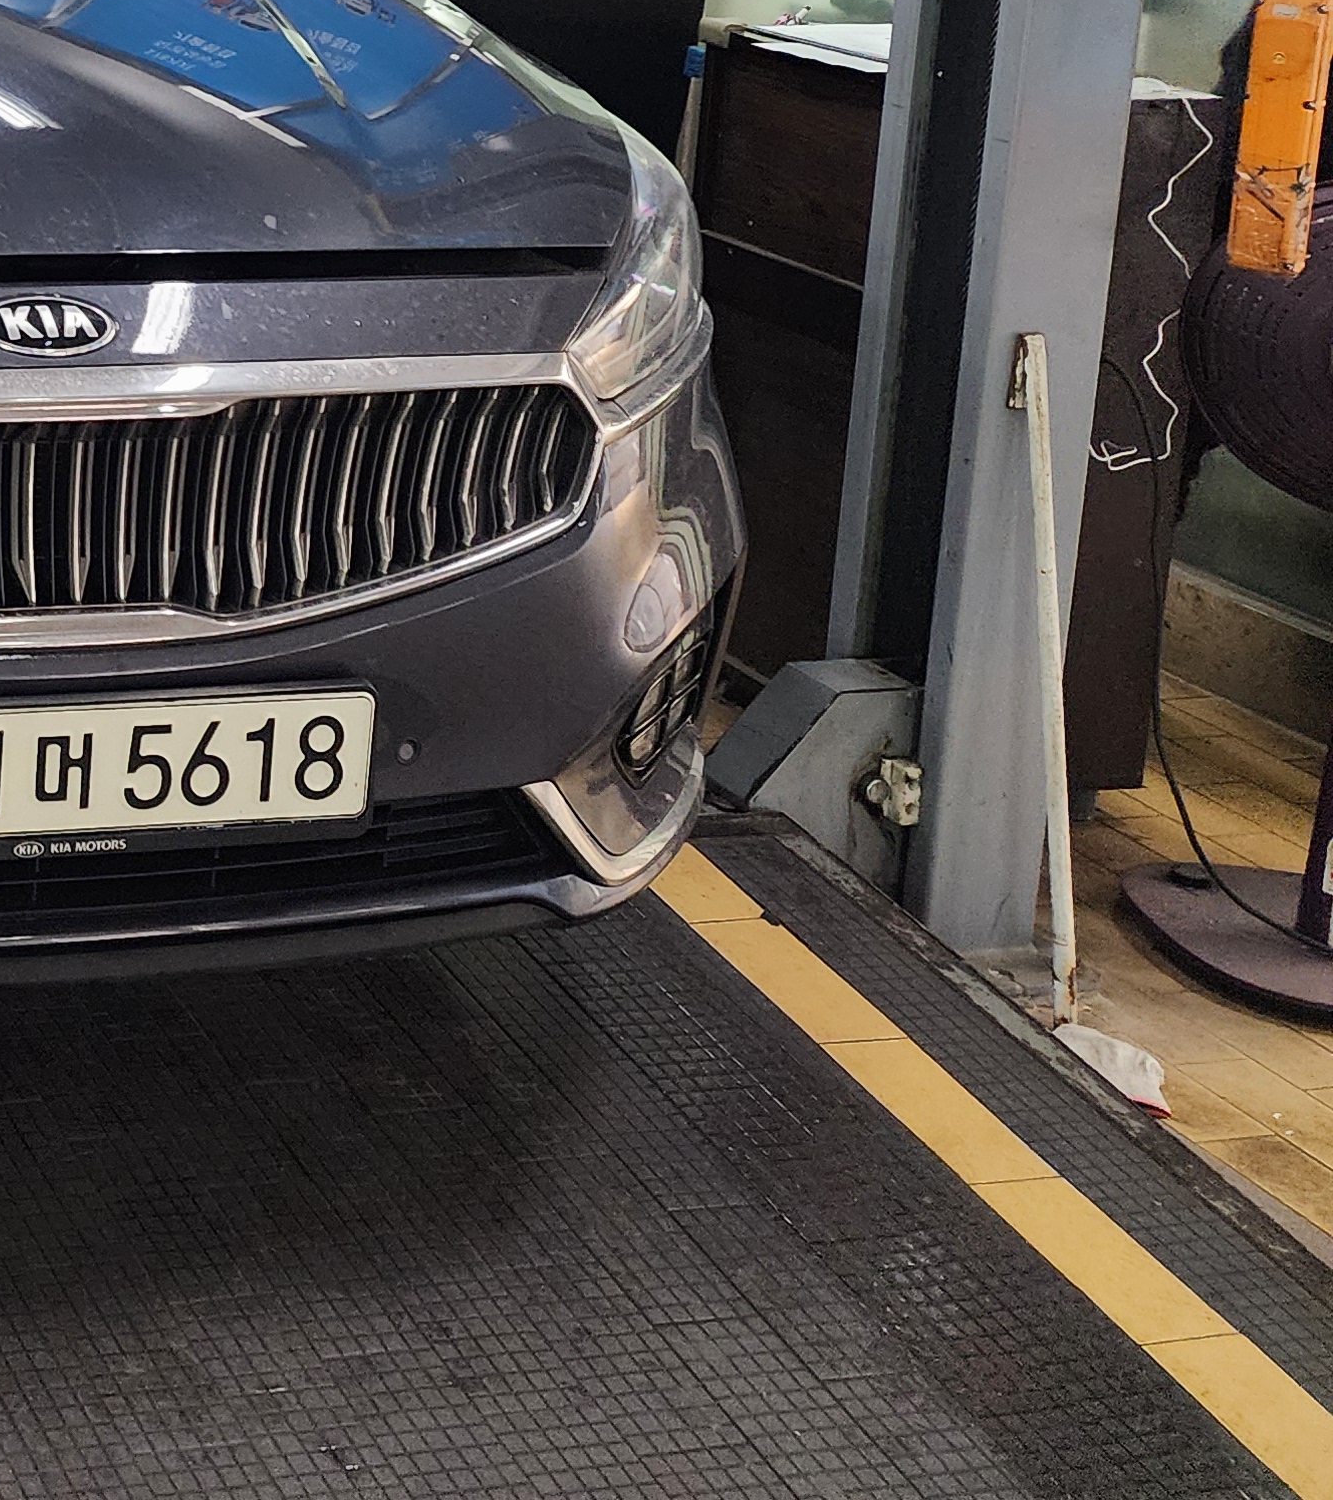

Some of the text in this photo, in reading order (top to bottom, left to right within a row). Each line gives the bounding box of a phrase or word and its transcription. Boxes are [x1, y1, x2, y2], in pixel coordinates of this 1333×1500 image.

[123, 713, 346, 811] 5618
[18, 838, 127, 856] KIA KIA MOTORS
